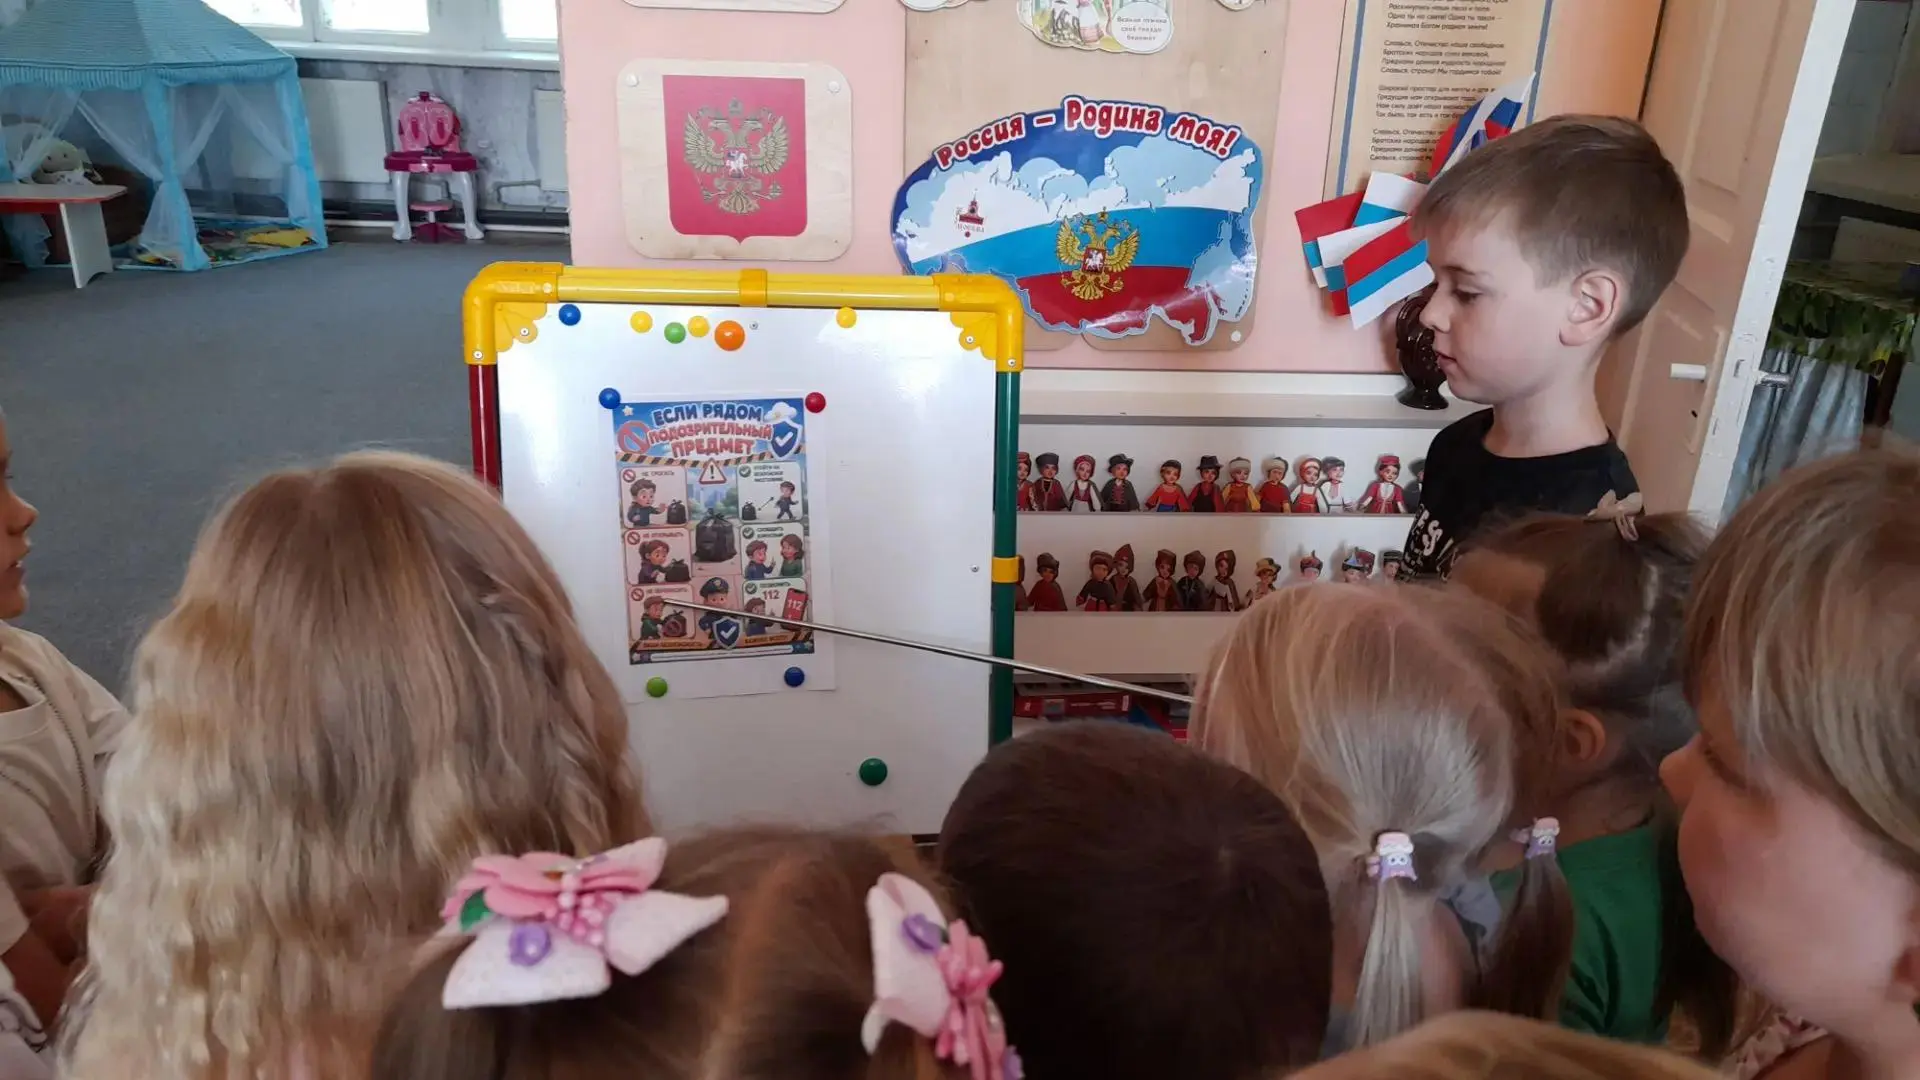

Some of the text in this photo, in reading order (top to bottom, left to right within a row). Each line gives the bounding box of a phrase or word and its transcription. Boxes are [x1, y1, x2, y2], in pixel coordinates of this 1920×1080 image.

[935, 115, 1025, 168] Россия
[1064, 99, 1162, 136] Родина
[1171, 114, 1240, 157] моя!
[652, 402, 764, 426] ЕСЛИ РЯДОМ
[649, 420, 774, 446] ПОДОЗРИТЕЛЬНЫЙ
[671, 437, 756, 459] ПРЕДМЕТ
[763, 589, 780, 600] 112
[787, 598, 804, 611] 112
